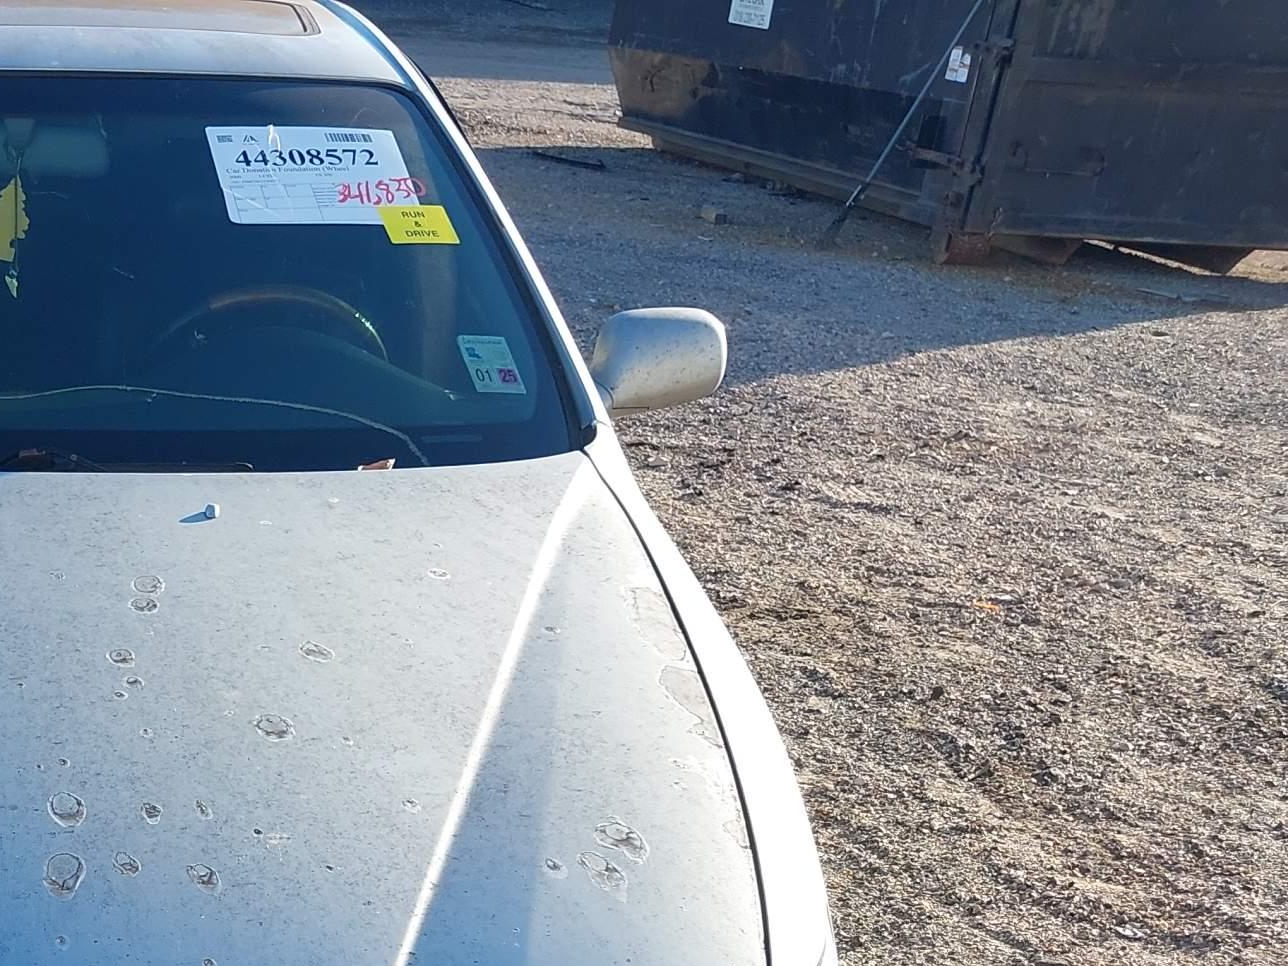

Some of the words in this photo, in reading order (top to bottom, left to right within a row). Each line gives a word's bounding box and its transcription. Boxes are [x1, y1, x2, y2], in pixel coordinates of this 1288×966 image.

[235, 149, 379, 167] 44308572
[414, 220, 422, 228] &
[405, 230, 440, 238] DRIVE
[475, 368, 493, 383] 01
[498, 368, 518, 383] 25
